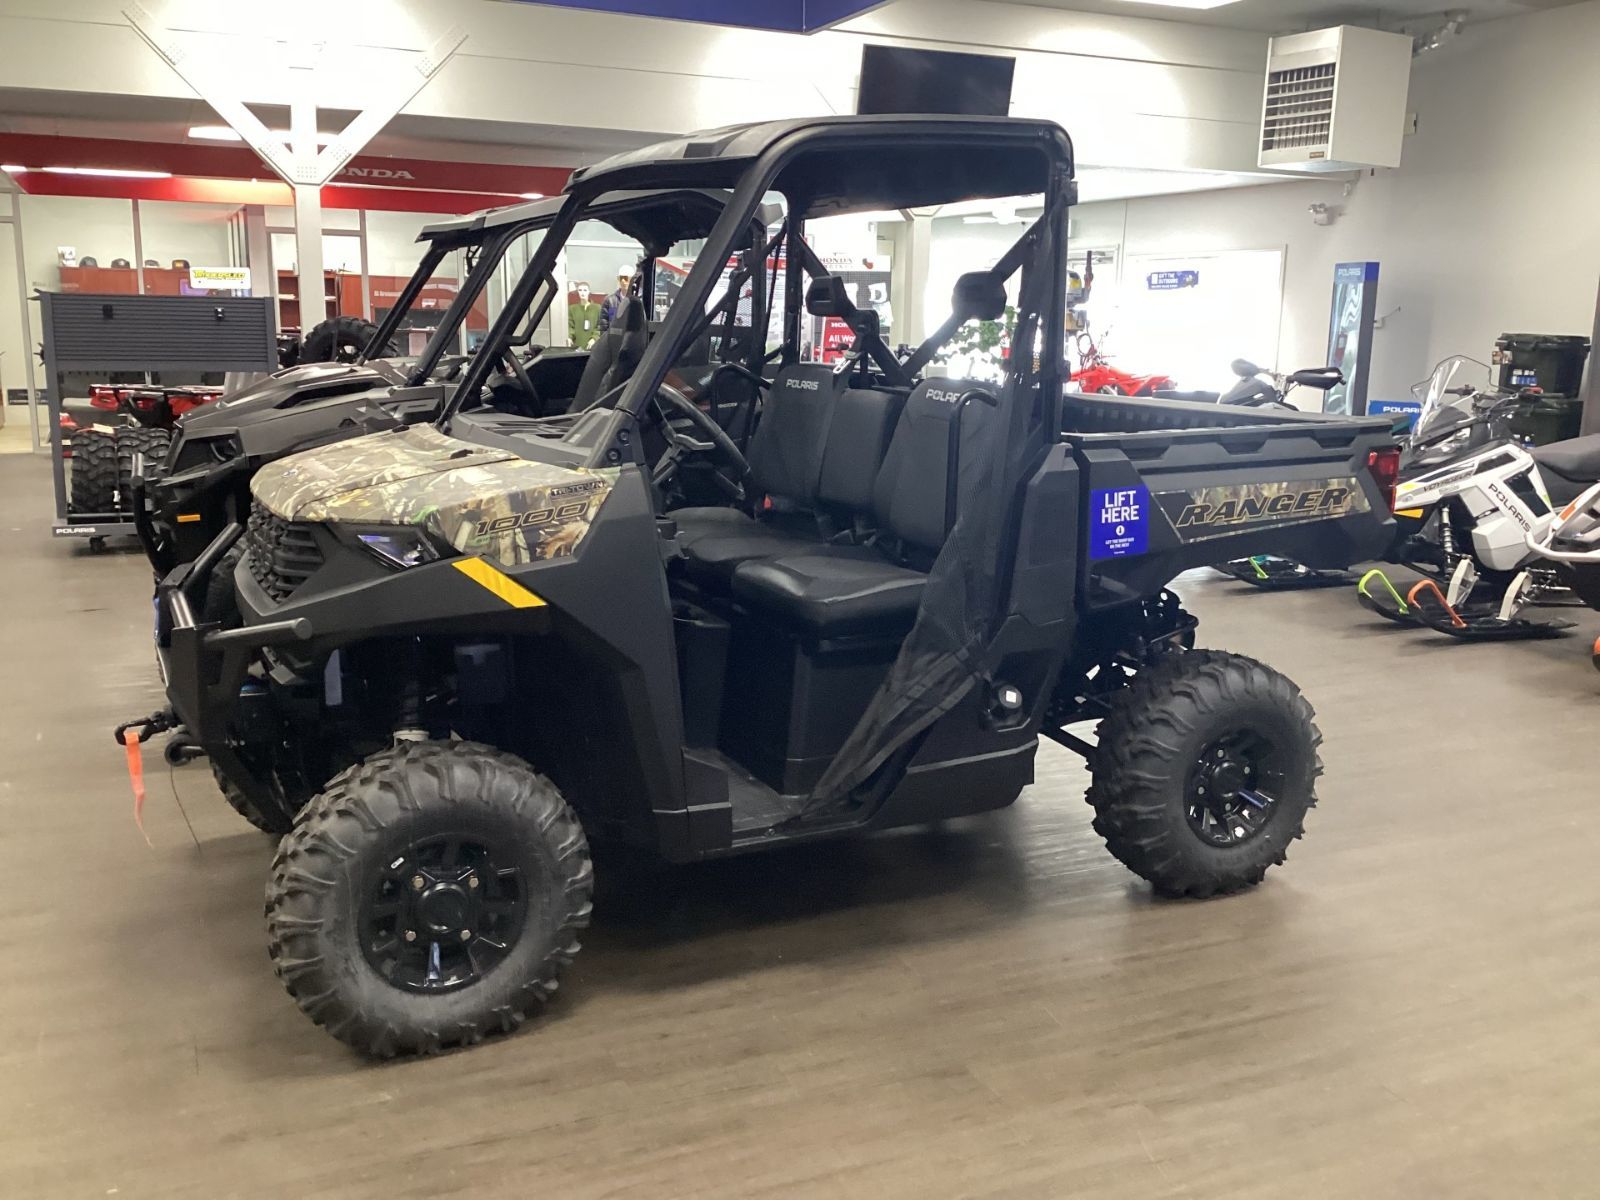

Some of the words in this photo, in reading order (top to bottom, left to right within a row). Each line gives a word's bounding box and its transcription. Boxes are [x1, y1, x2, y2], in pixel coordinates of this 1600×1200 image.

[337, 167, 415, 180] NDA
[785, 379, 819, 390] POLARIS
[1105, 490, 1137, 508] LIFT
[1176, 487, 1349, 527] RANGER
[1488, 484, 1531, 532] POLARIS
[475, 501, 589, 537] 1000
[1101, 505, 1139, 523] HERE
